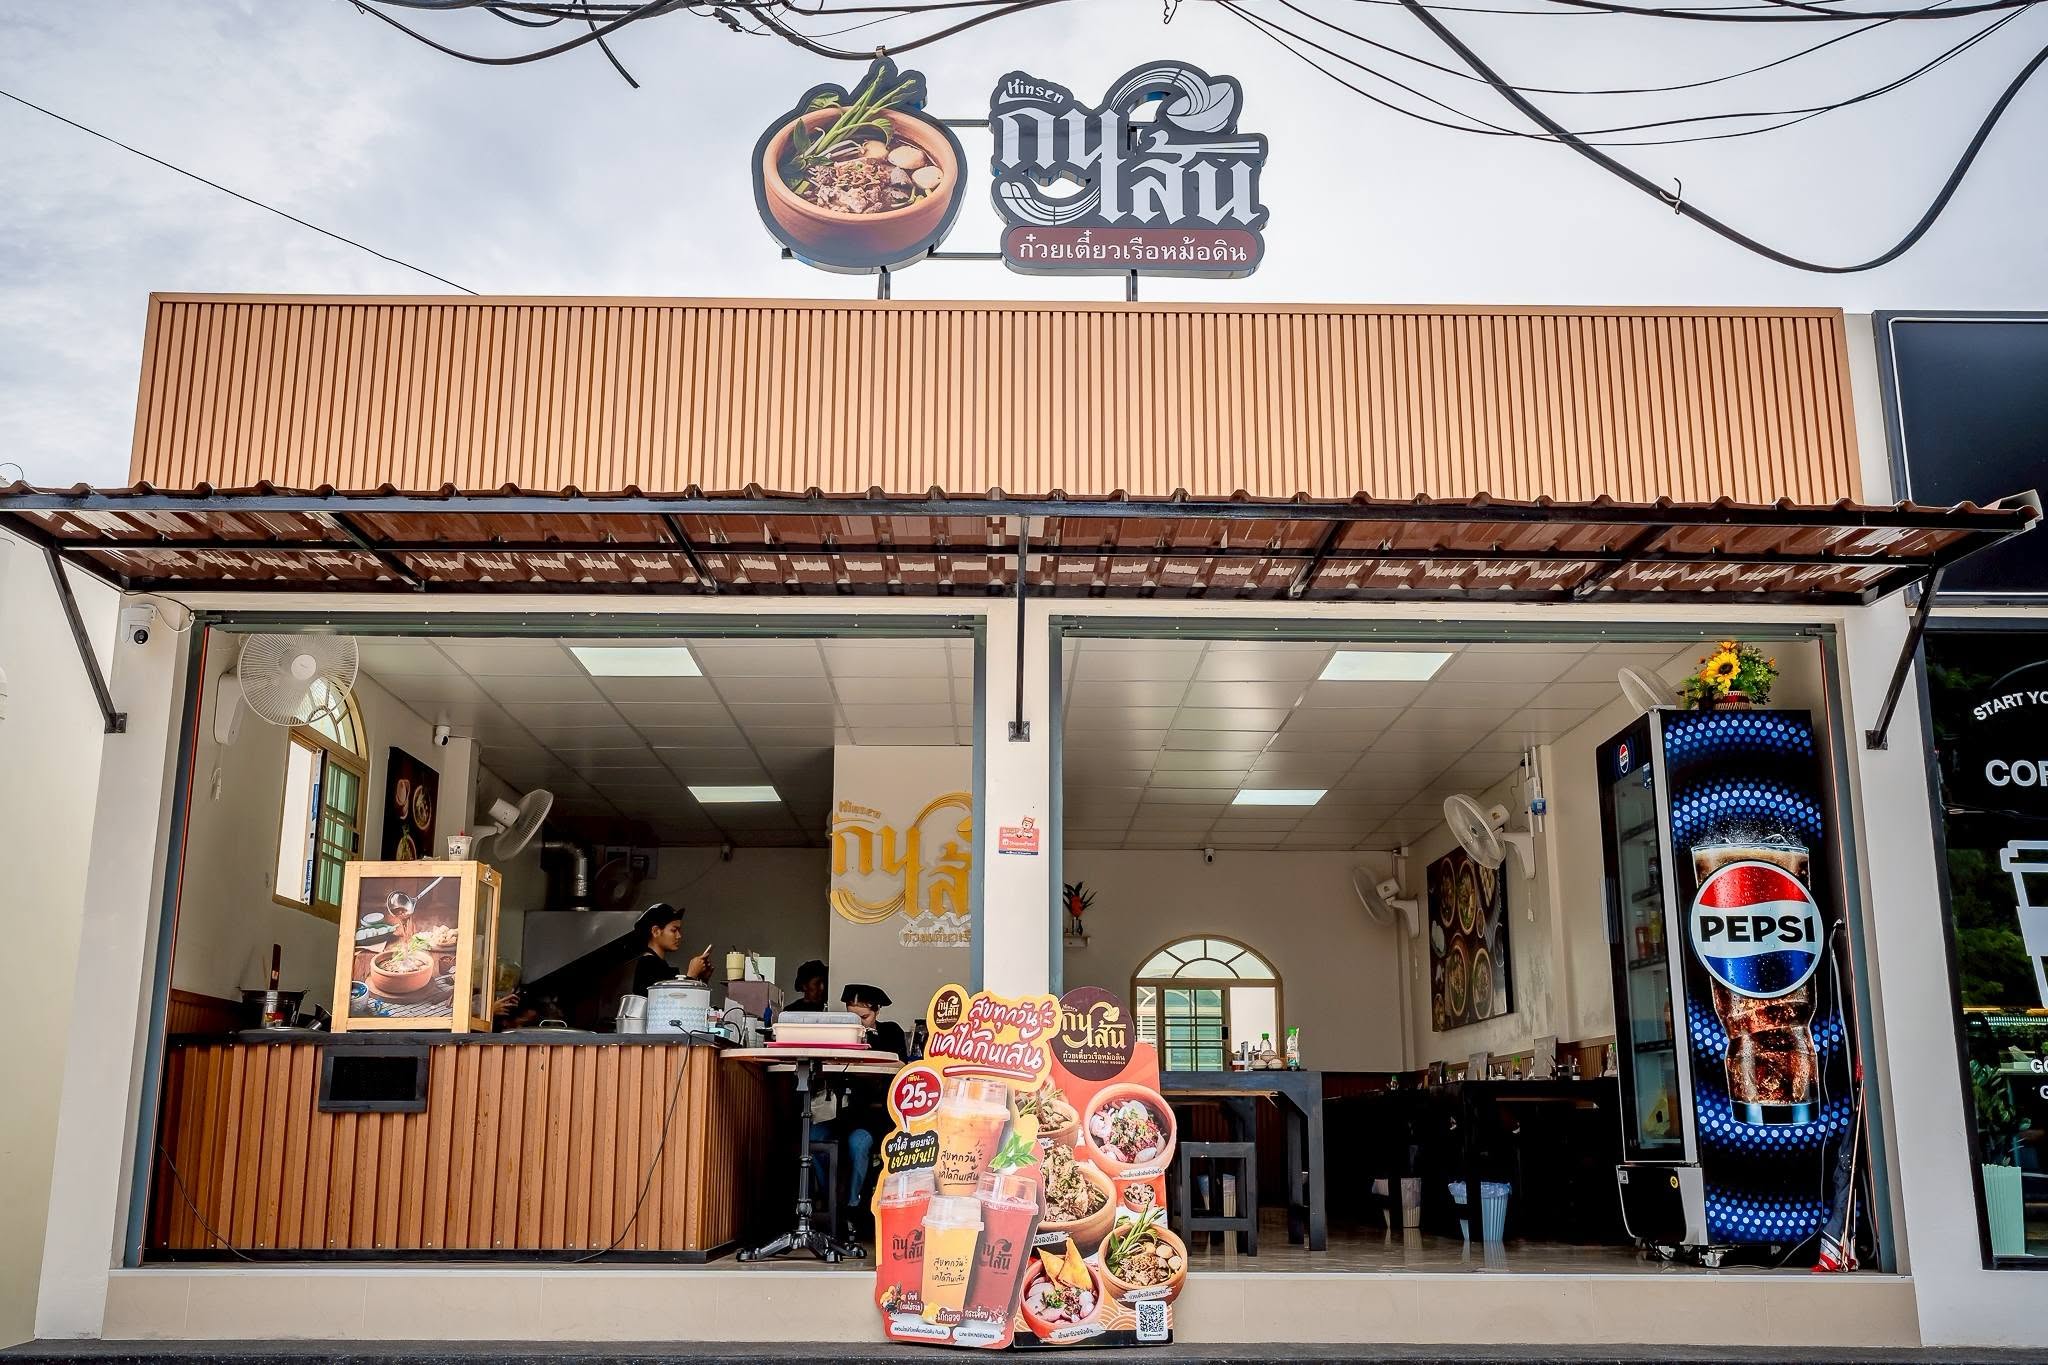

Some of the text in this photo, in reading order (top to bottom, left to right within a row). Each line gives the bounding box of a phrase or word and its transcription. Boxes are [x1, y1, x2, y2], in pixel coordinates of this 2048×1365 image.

[1007, 78, 1064, 104] Kinsen
[1019, 229, 1248, 263] ก๋วยเตี๋ยวเรือหม้อดิน
[1973, 692, 2024, 721] START
[1699, 915, 1816, 943] PEPSI
